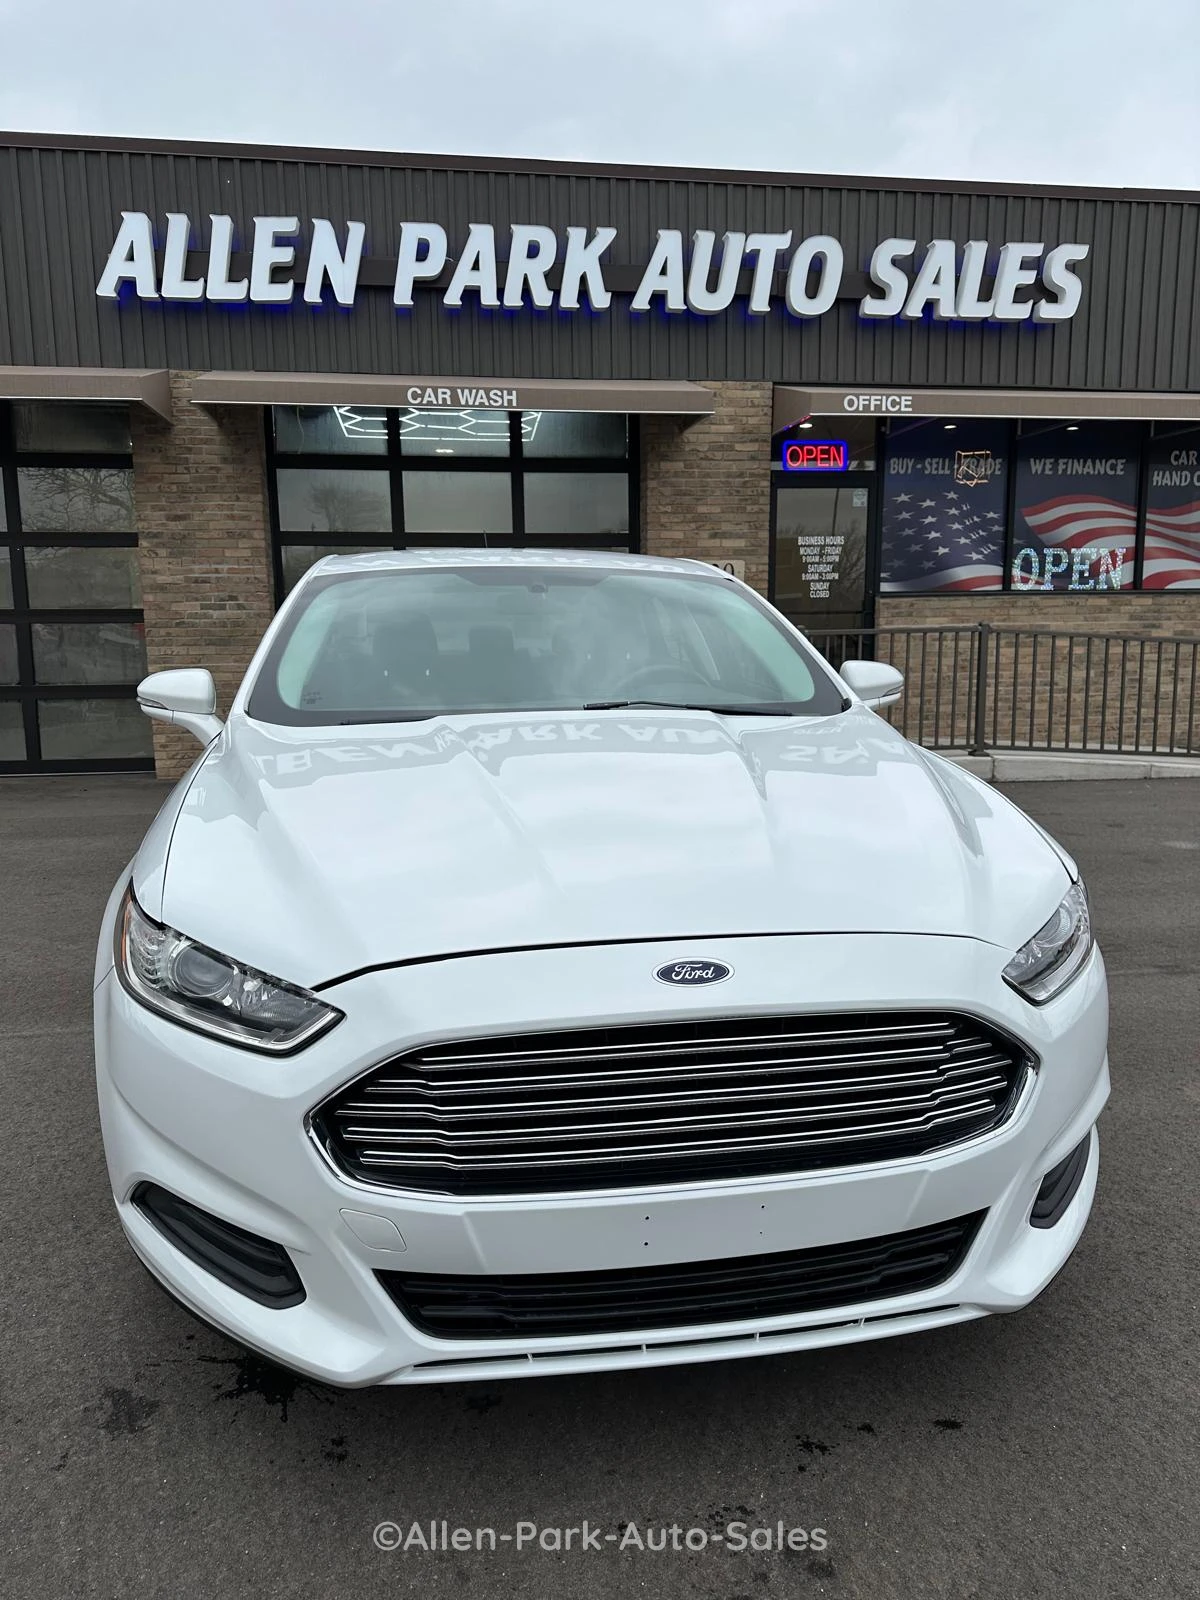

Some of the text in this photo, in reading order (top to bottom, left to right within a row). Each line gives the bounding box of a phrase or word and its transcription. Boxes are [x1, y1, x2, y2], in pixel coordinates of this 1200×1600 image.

[96, 211, 1090, 324] ALLEN PARK AUTO SALES
[406, 387, 518, 407] CAR WASH
[843, 394, 913, 412] OFFICE
[786, 445, 844, 468] OPEN
[1170, 450, 1198, 466] CAR
[889, 458, 915, 474] BUY
[924, 458, 951, 475] SELL
[1029, 457, 1126, 476] WE FINANCE
[1152, 470, 1191, 487] HAND
[798, 536, 845, 545] BUSINESS HOURS
[799, 547, 821, 555] MONDAY
[824, 547, 842, 555] FRIDAY
[807, 564, 833, 573] SATURDAY
[1011, 547, 1127, 591] OPEN
[810, 582, 830, 590] SUNDAY
[671, 963, 715, 981] Ford
